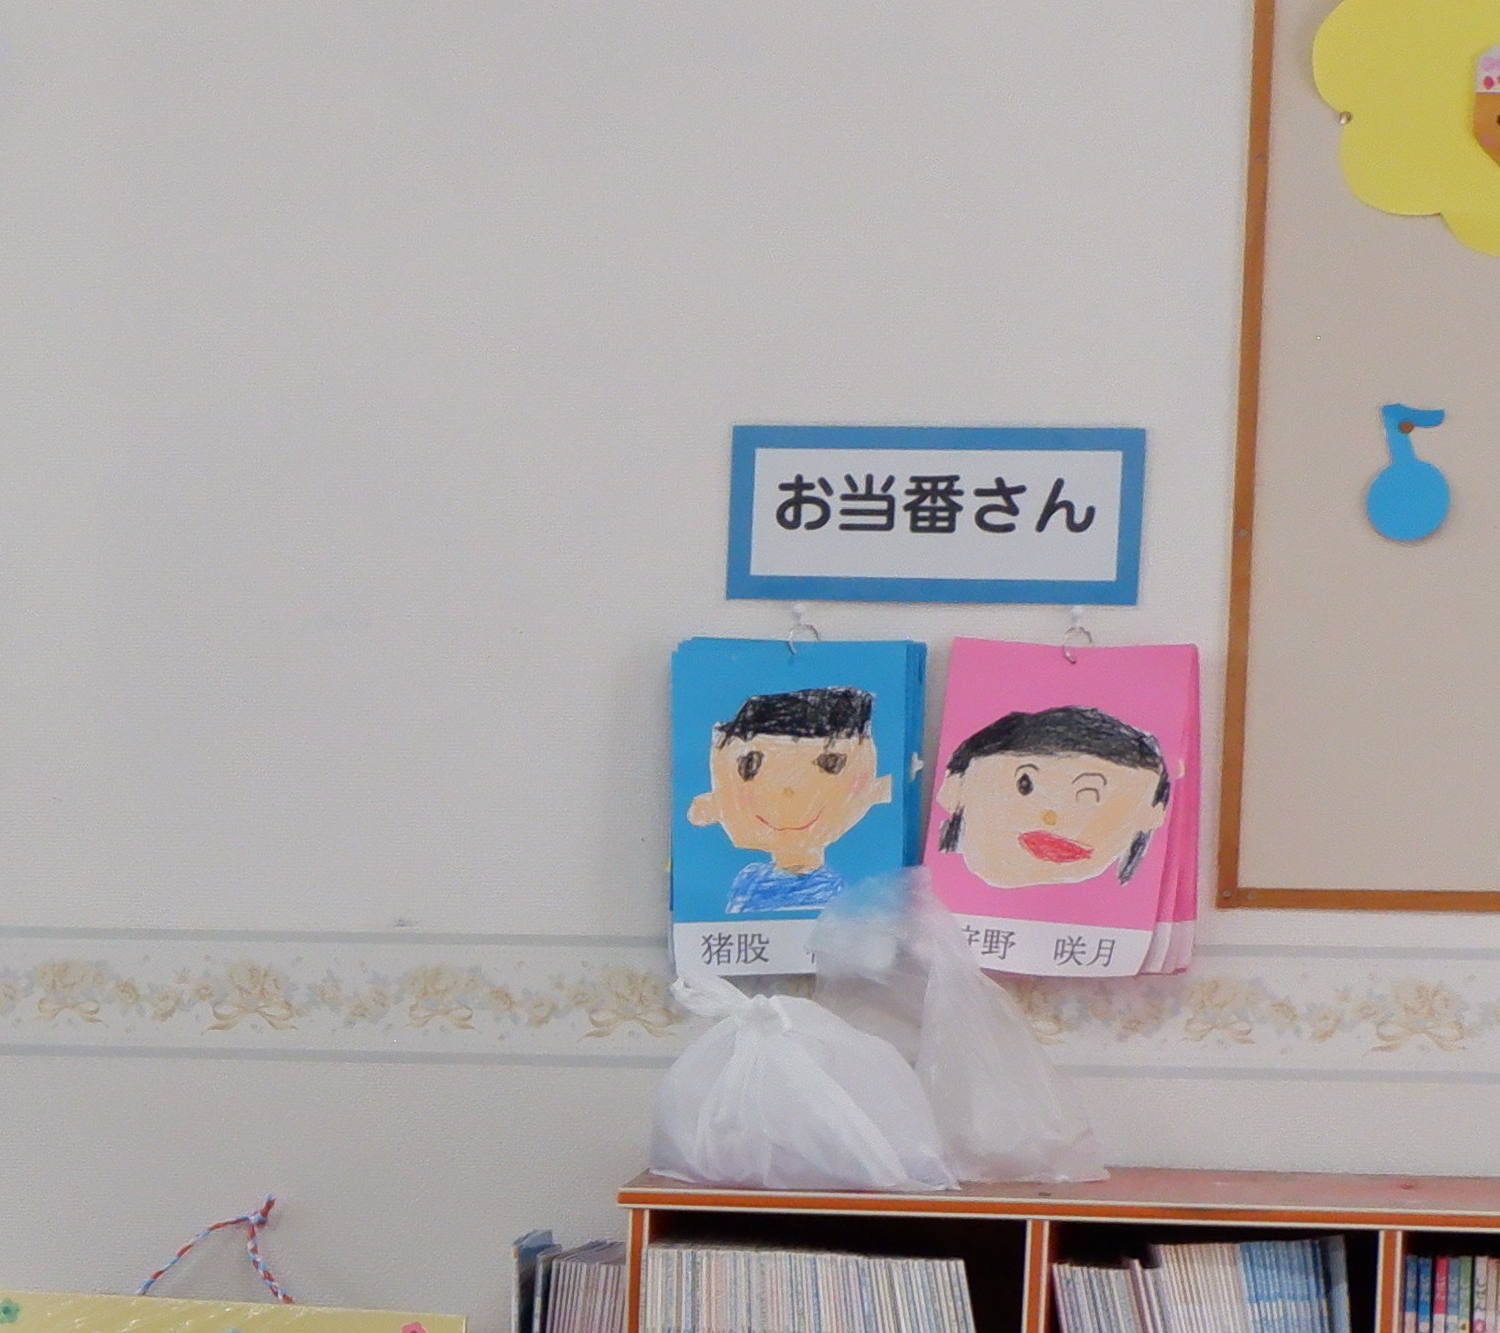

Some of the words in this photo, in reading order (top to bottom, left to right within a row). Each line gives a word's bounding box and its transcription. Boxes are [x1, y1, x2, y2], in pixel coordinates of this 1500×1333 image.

[774, 473, 1097, 535] お当番さん
[700, 932, 770, 966] 猪股
[1052, 935, 1117, 968] 咲月
